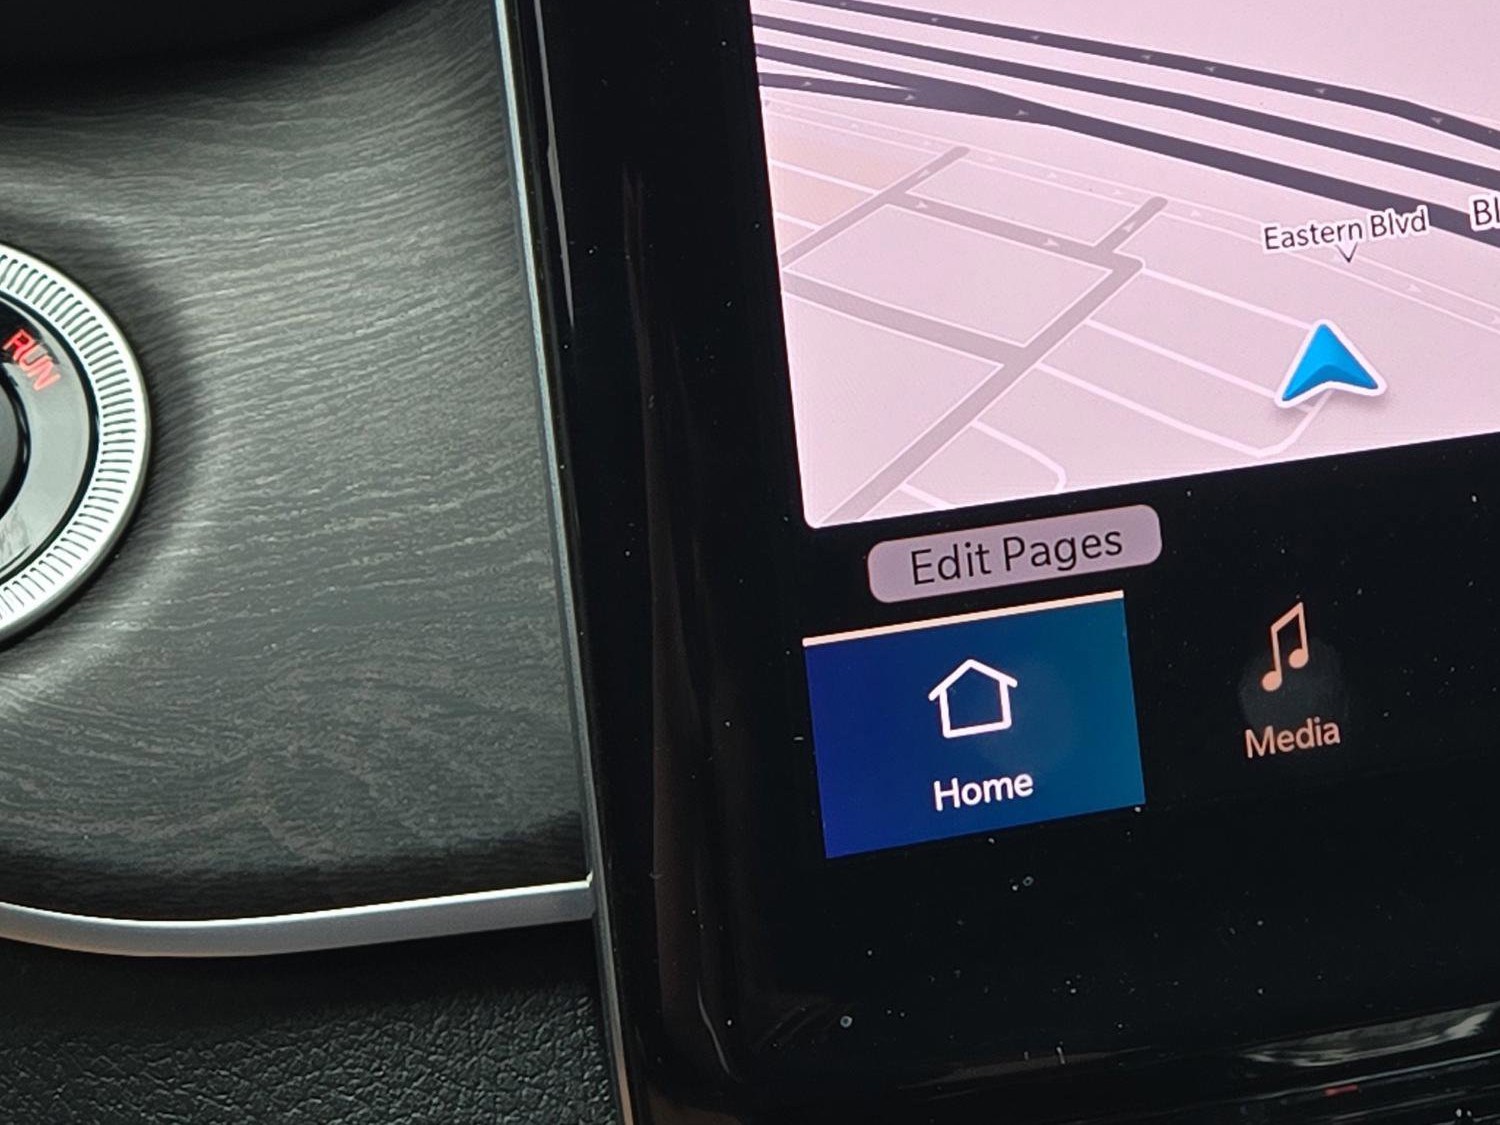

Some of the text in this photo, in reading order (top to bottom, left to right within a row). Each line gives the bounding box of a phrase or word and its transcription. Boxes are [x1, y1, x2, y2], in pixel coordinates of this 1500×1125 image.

[1264, 209, 1428, 250] Eastern Blvd
[2, 328, 61, 392] RUN
[911, 530, 1123, 586] Edit Pages
[1244, 716, 1341, 759] Media
[933, 772, 1034, 812] Home
